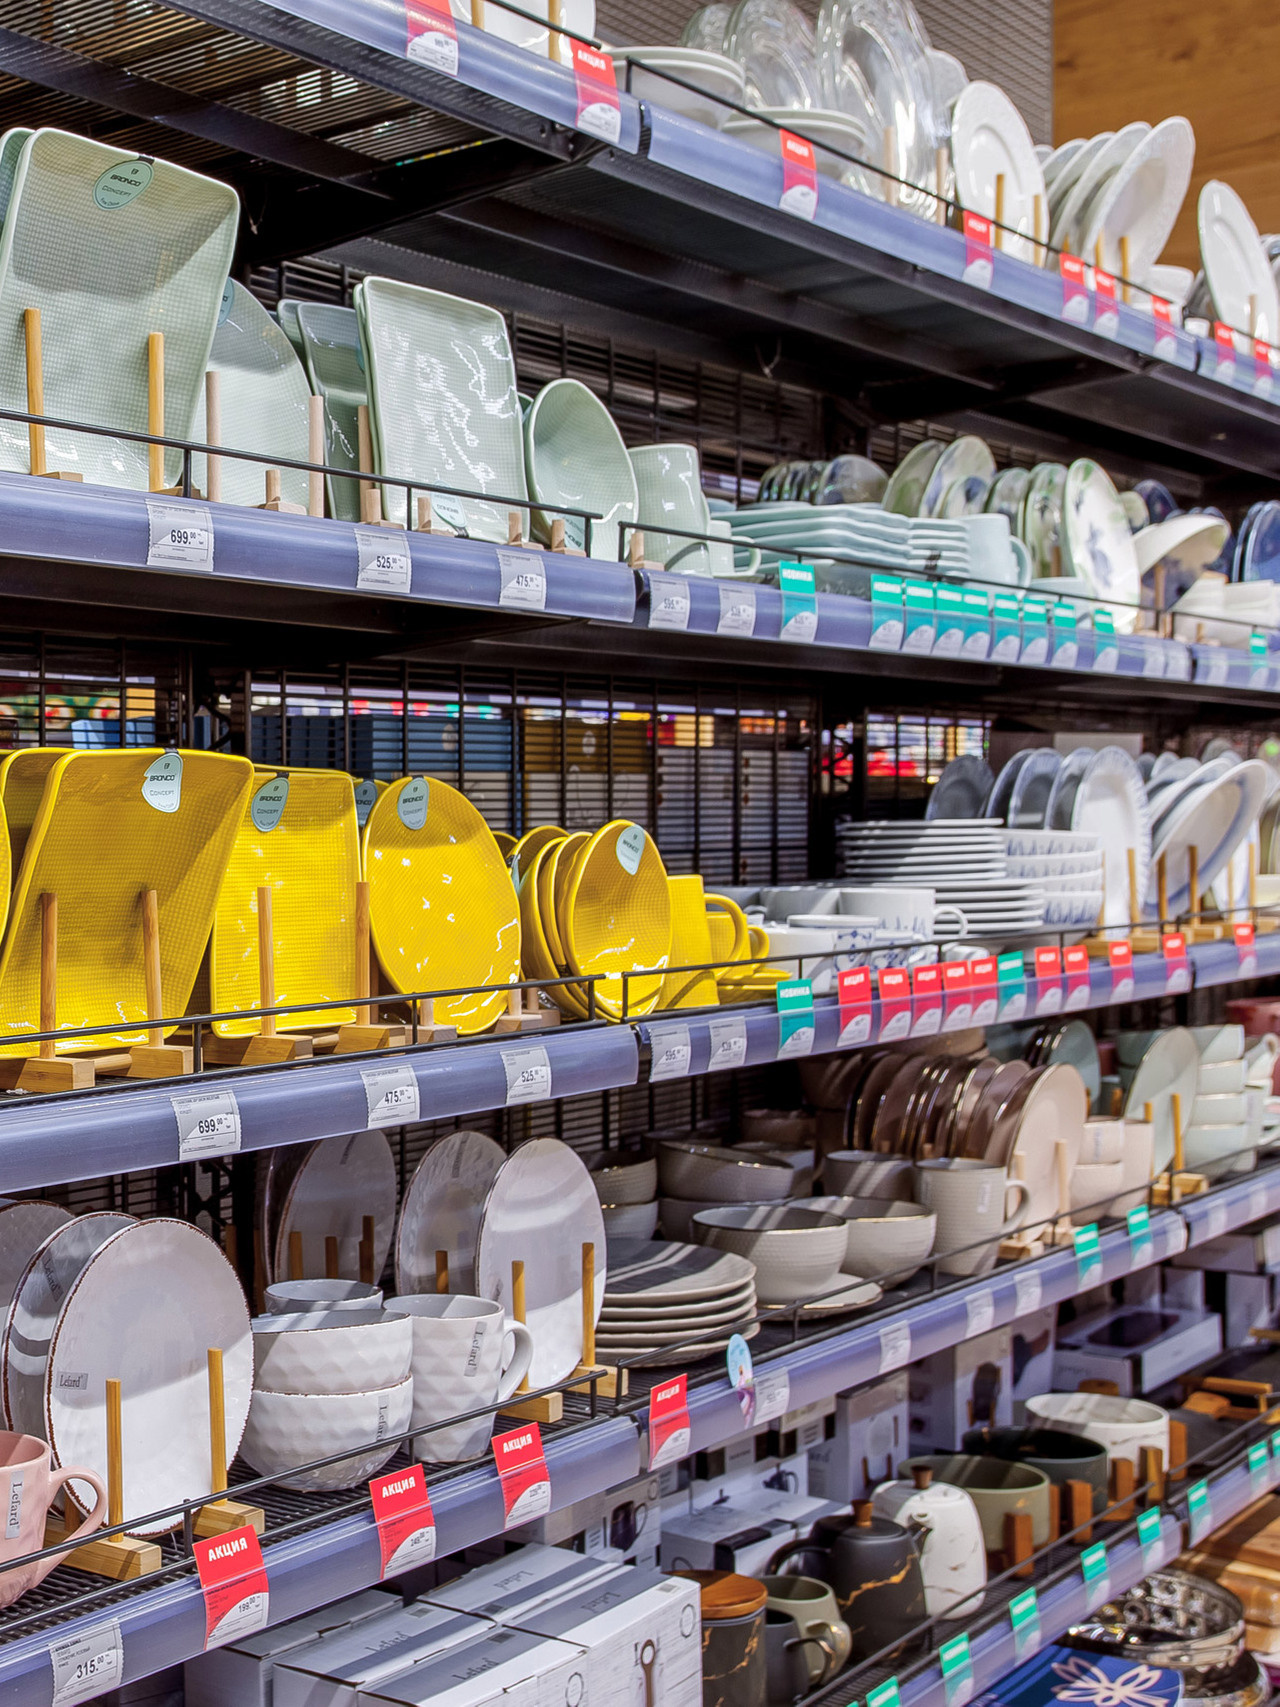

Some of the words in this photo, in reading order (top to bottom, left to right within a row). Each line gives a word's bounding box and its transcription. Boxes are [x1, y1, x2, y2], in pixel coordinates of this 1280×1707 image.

[110, 174, 141, 186] BRONCO
[150, 774, 175, 782] BRONCO
[468, 1330, 484, 1367] Lefard
[60, 1375, 80, 1388] Lefard
[503, 1433, 532, 1454] АКЦИЯ
[382, 1476, 416, 1498] АКЦИЯ
[9, 1482, 23, 1526] Lefard
[208, 1537, 248, 1562] АКЦИЯ
